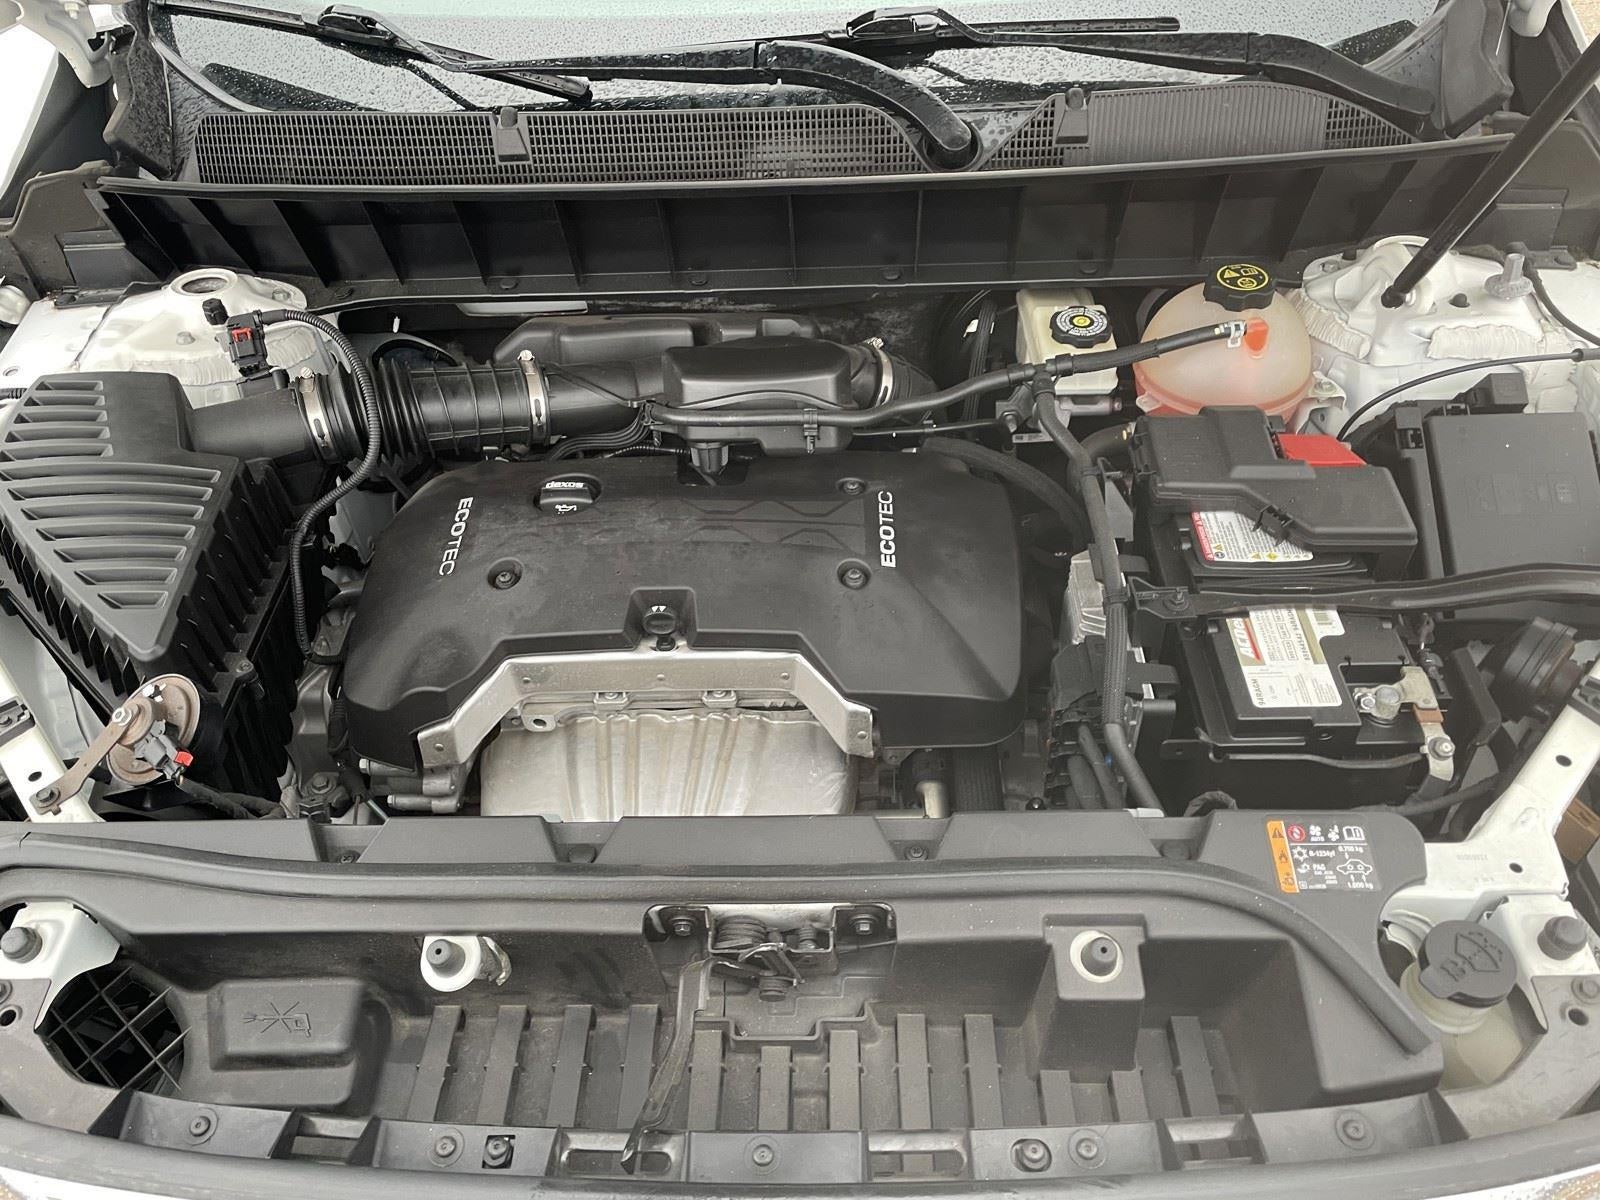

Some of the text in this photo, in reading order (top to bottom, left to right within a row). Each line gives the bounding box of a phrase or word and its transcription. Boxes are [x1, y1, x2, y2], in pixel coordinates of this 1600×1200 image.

[545, 481, 585, 489] dexos
[438, 496, 474, 576] ECOTEC
[877, 490, 897, 568] ECOTEC
[1251, 678, 1265, 706] 94RAGM
[1312, 863, 1326, 871] PAG
